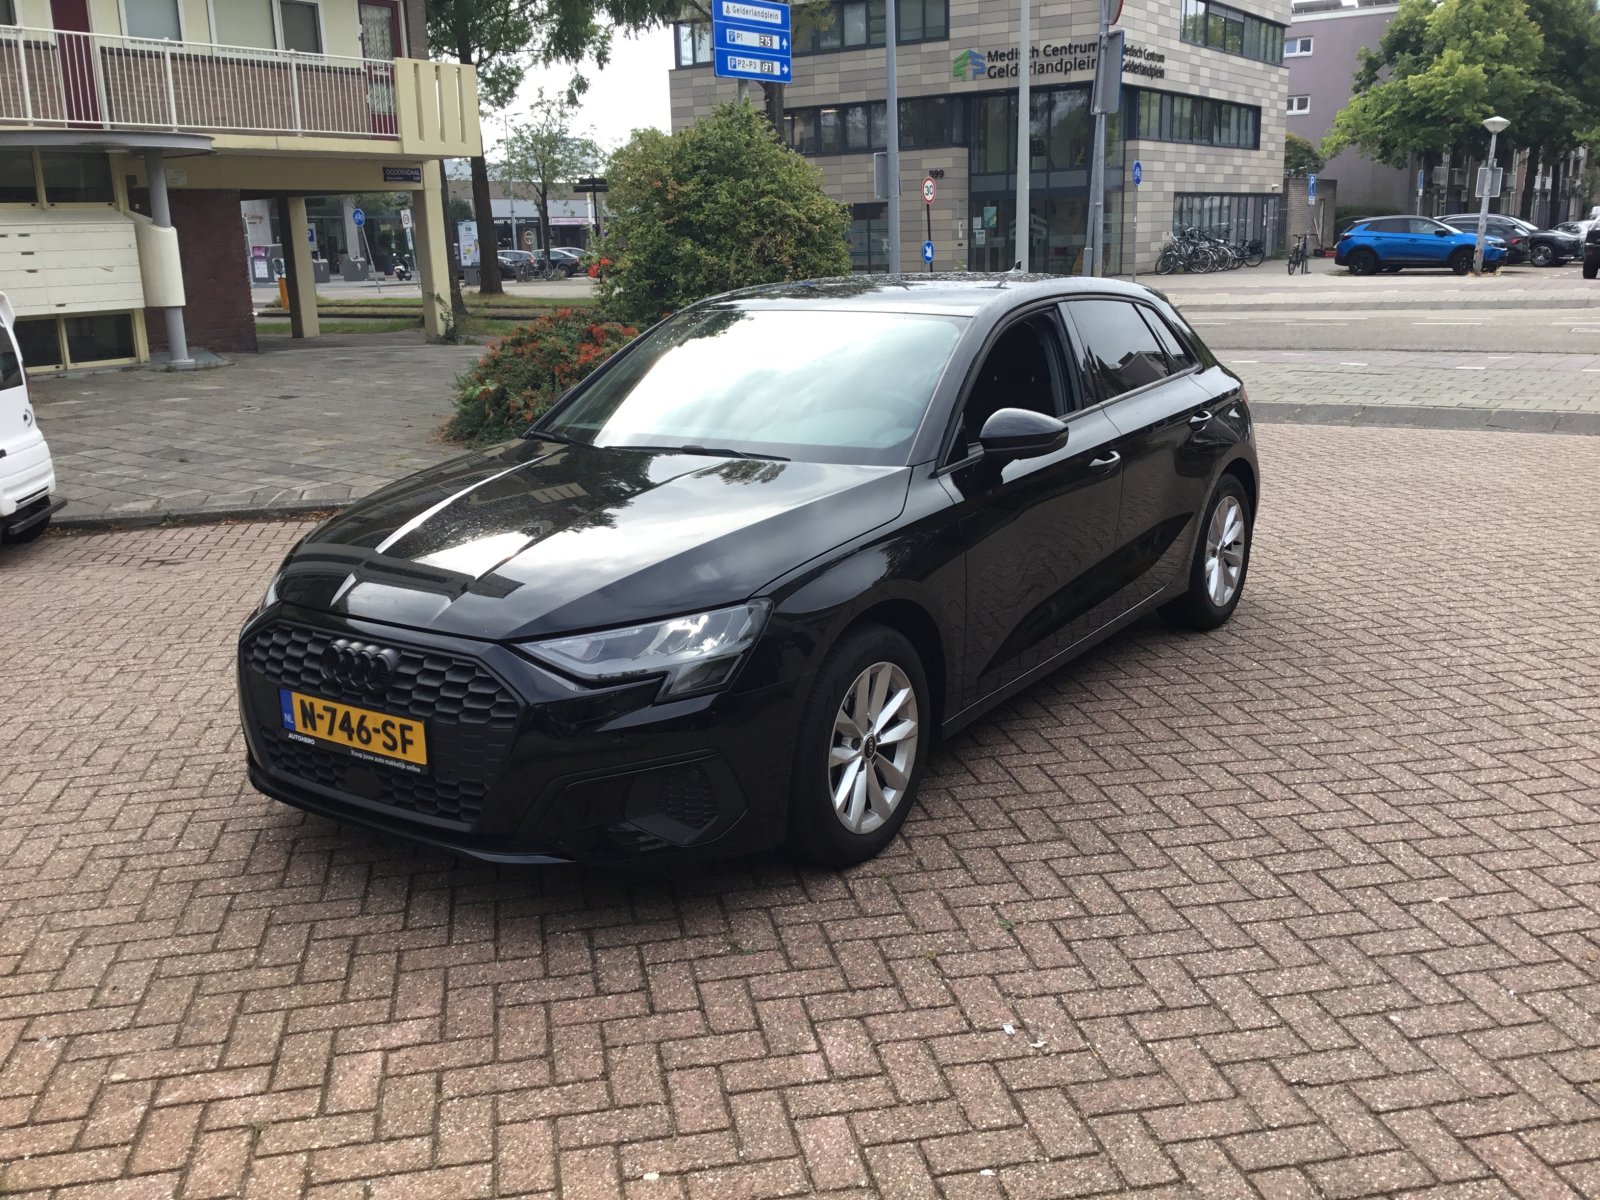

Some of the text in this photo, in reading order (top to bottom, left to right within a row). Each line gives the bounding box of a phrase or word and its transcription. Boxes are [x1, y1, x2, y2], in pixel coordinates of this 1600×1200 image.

[732, 5, 779, 20] Gelderlandplein
[736, 32, 743, 42] P1
[987, 46, 1039, 62] Medih
[737, 59, 757, 70] P2-P3
[925, 184, 934, 196] 30
[284, 713, 294, 724] NL
[299, 699, 414, 755] N-746-SF
[288, 733, 315, 745] AUTOHERO
